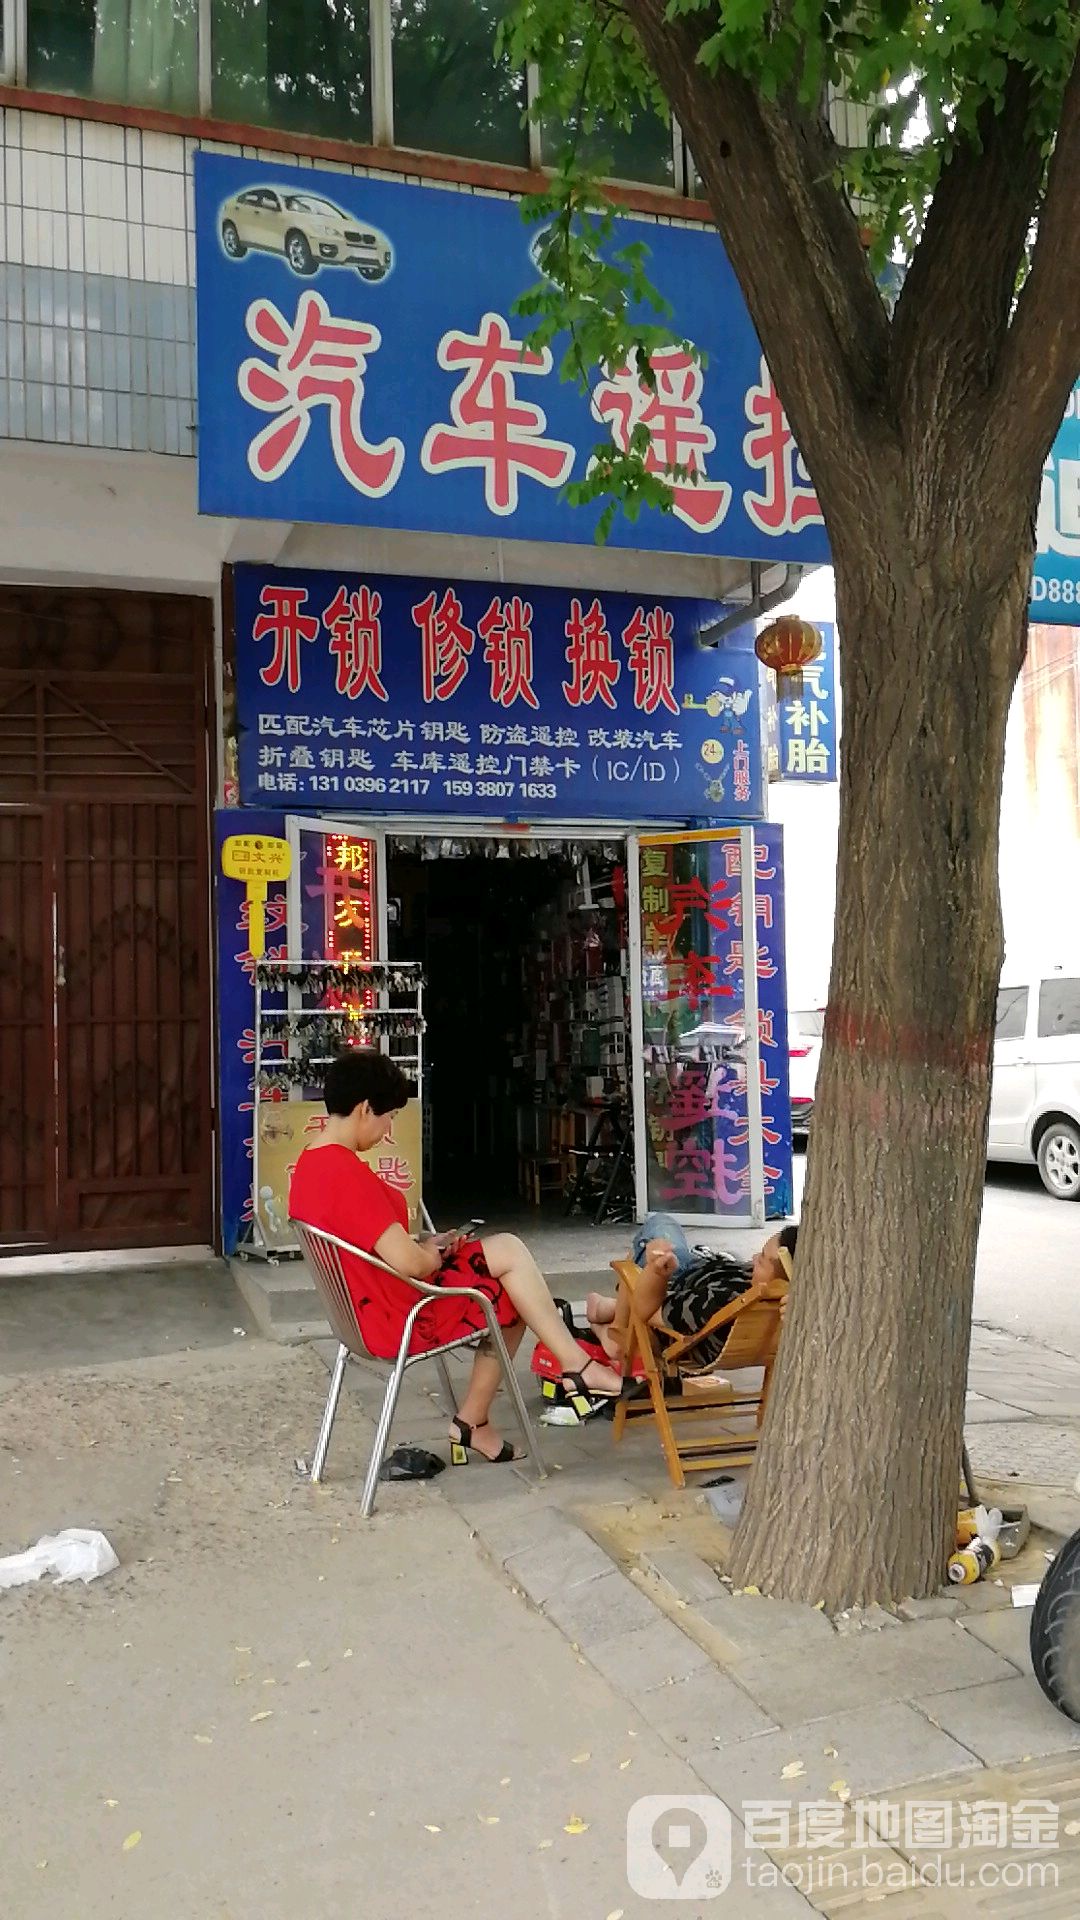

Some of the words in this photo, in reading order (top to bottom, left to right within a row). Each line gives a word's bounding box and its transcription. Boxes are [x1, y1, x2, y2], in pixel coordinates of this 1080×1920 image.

[252, 584, 390, 703] 开锁
[412, 587, 541, 710] 修锁
[562, 598, 681, 716] 换锁
[784, 630, 831, 774] 气补胎
[257, 713, 471, 744] 匹配汽车芯片钥匙
[479, 723, 581, 748] 防盗遥控
[587, 728, 683, 751] 改装汽车
[257, 744, 376, 772] 折叠钥匙
[390, 749, 581, 779] 车库遥控门禁卡
[257, 772, 305, 792] 电话:
[308, 774, 340, 792] 131
[343, 776, 387, 794] 0396
[388, 778, 430, 796] 2117
[443, 780, 473, 797] 159
[475, 781, 515, 798] 3807
[519, 783, 557, 799] 1633
[733, 739, 751, 801] 上门服务
